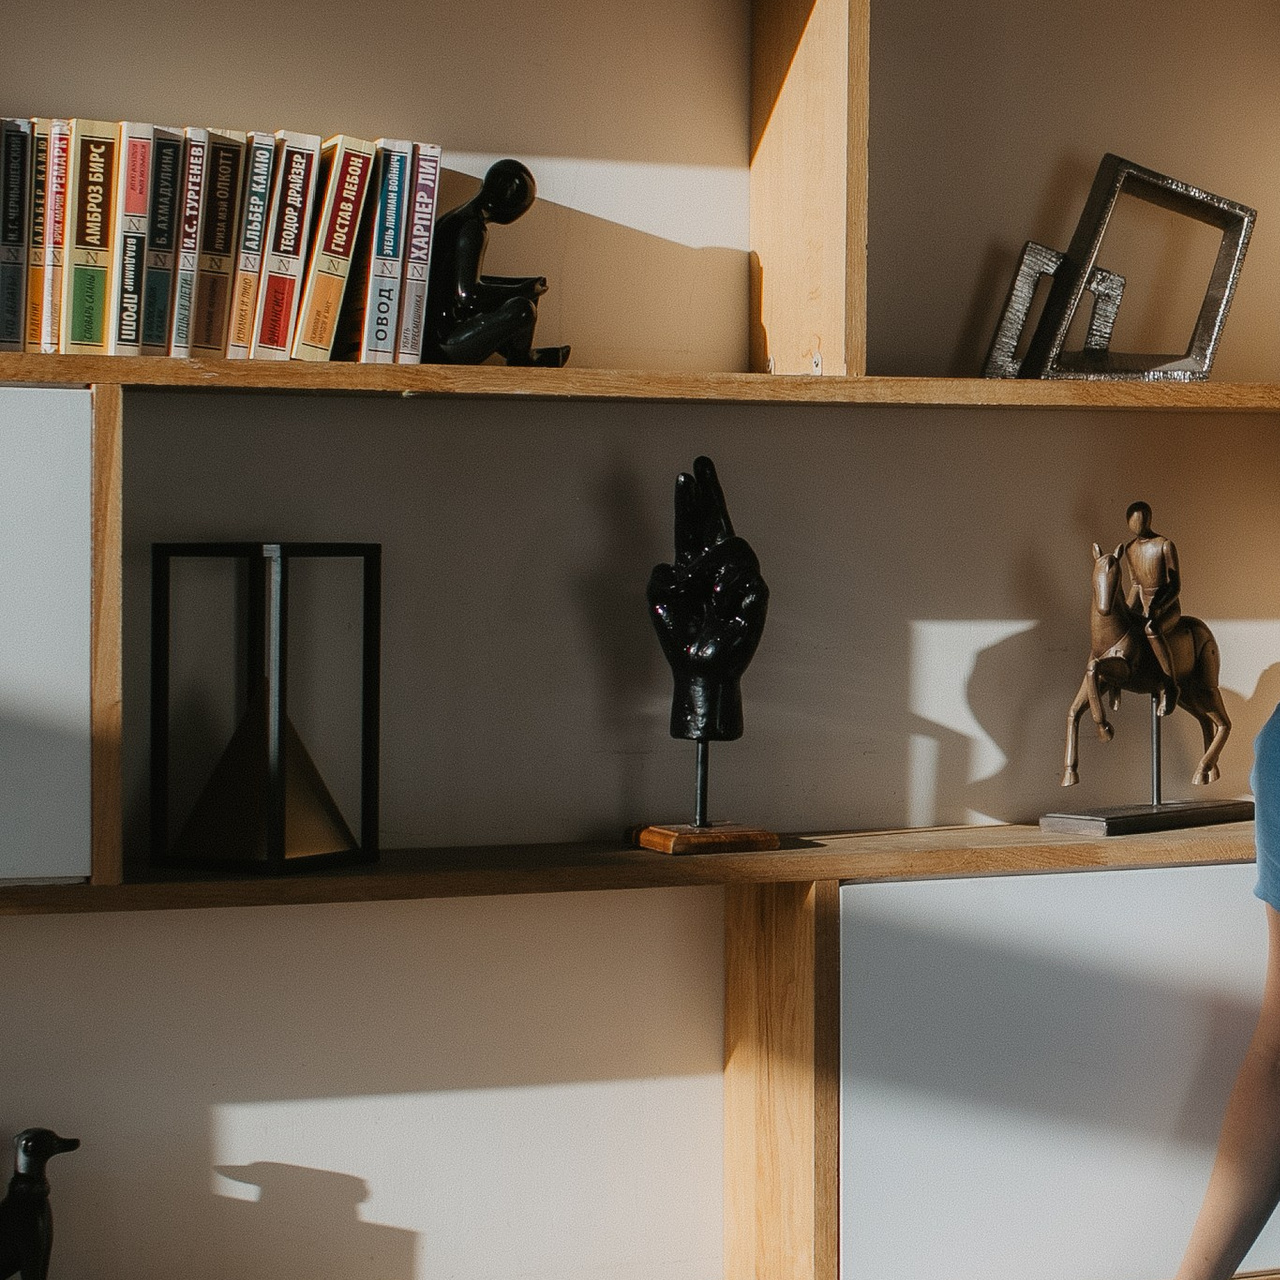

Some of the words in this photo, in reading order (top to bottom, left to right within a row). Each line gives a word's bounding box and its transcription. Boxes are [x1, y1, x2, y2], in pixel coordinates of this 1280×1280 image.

[37, 140, 47, 180] КАМЮ
[52, 139, 68, 192] РЕМАРК
[88, 144, 106, 182] БИРС
[216, 150, 233, 199] ОЛКОТТ
[251, 149, 270, 193] КАМЮ
[387, 155, 401, 192] ВОЙНИЧ
[418, 159, 437, 188] ЛИ
[157, 148, 174, 230] АХМАДУЛИНА
[186, 147, 203, 216] ТУРГЕНЕВ
[287, 154, 307, 207] ДРАЙЗЕР
[33, 189, 45, 242] АЛЬБЕР
[54, 194, 64, 220] МАРИЯ
[85, 185, 104, 245] АМБРОЗ
[245, 196, 264, 250] АЛЬБЕР
[331, 201, 353, 252] ГЮСТАВ
[342, 156, 364, 201] ЛЕБОН
[385, 192, 398, 228] ЛИЛИАН
[53, 222, 63, 243] ЭРИХ
[156, 233, 168, 244] Б.
[183, 233, 196, 248] И.
[184, 220, 197, 233] С.
[215, 224, 226, 250] ЛУИЗА
[281, 207, 299, 251] ТЕОДОР
[383, 228, 395, 256] ЭТЕЛЬ
[411, 192, 433, 260] ХАРПЕР
[123, 237, 137, 292] ВЛАДИМИР
[86, 274, 96, 304] САТАНЫ
[181, 277, 193, 303] ДЕТИ
[241, 277, 252, 300] ЛИЦО
[31, 302, 40, 338] ПАДЕНИЕ
[84, 306, 95, 340] СЛОВАРЬ
[121, 293, 138, 340] ПРОПП
[177, 312, 190, 339] ОТЦЫ
[236, 307, 248, 342] ИЗНАНКА
[268, 288, 285, 344] ФИНАНСИСТ
[375, 288, 394, 341] ОВОД
[410, 294, 423, 351] ПЕРЕСМЕШНИКА
[402, 327, 411, 349] УБИТЬ
